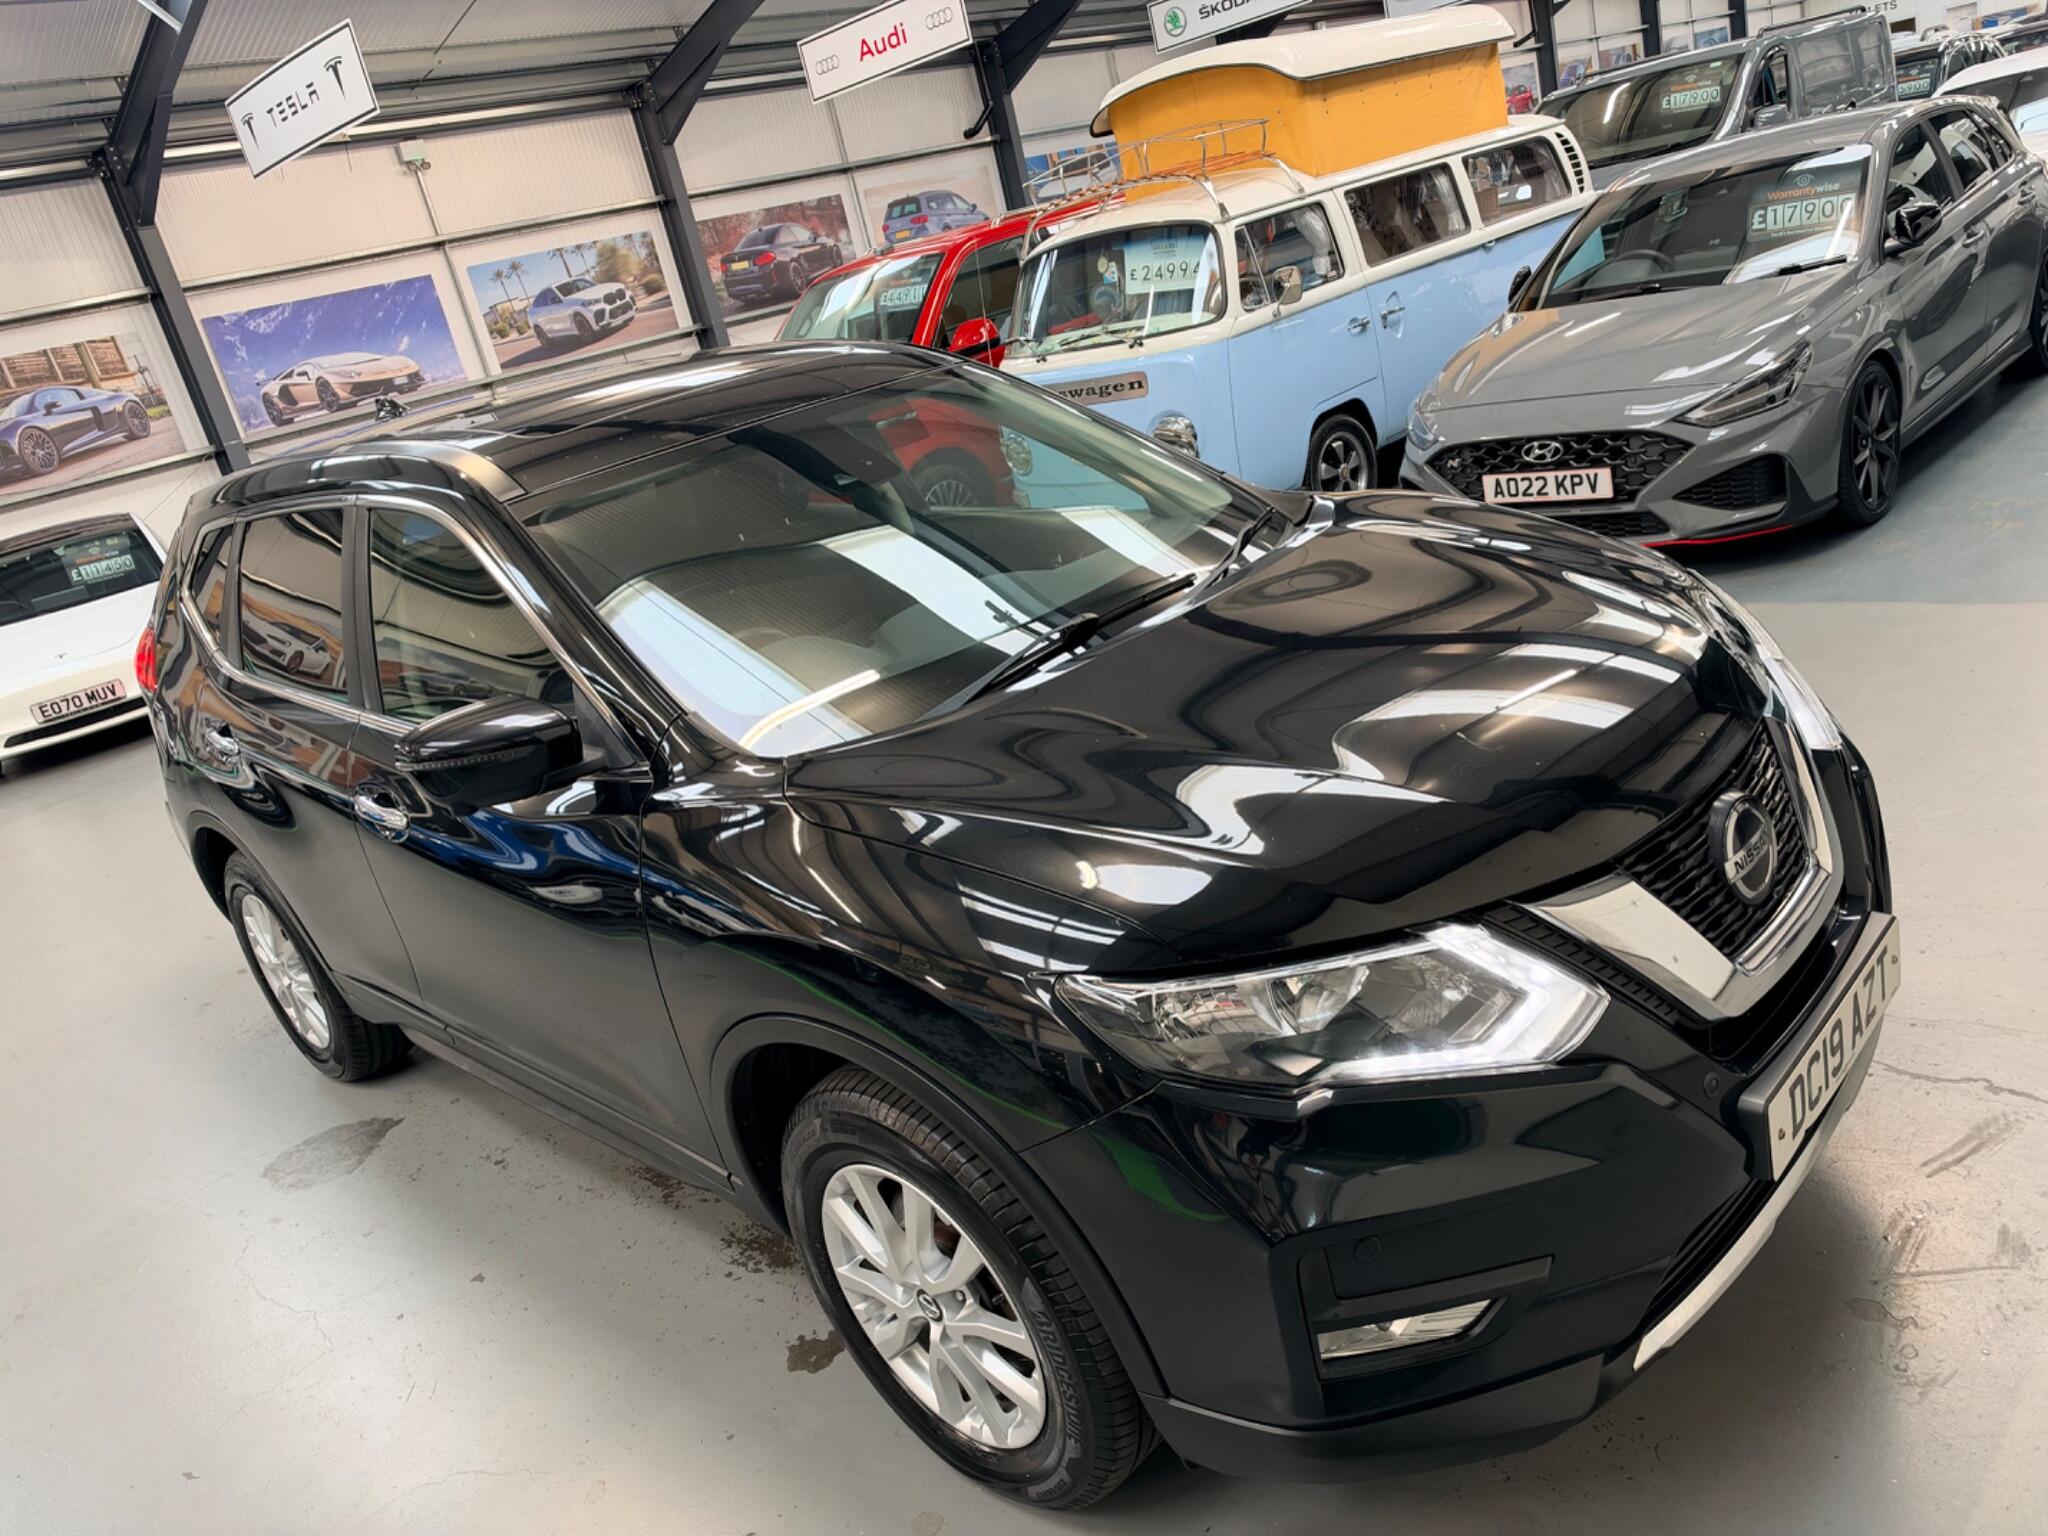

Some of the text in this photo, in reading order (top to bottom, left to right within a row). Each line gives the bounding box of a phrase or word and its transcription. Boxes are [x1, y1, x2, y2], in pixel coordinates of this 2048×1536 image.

[1198, 0, 1250, 20] ŠKOD
[859, 22, 908, 62] Audi
[266, 81, 321, 128] TESLA
[1662, 87, 1720, 109] £17900
[1767, 182, 1841, 201] Warrantywise
[1493, 472, 1599, 499] AO22 KPV
[85, 683, 117, 705] MUV
[1733, 826, 1772, 875] NISSA
[1788, 944, 1889, 1141] DC19 AZT
